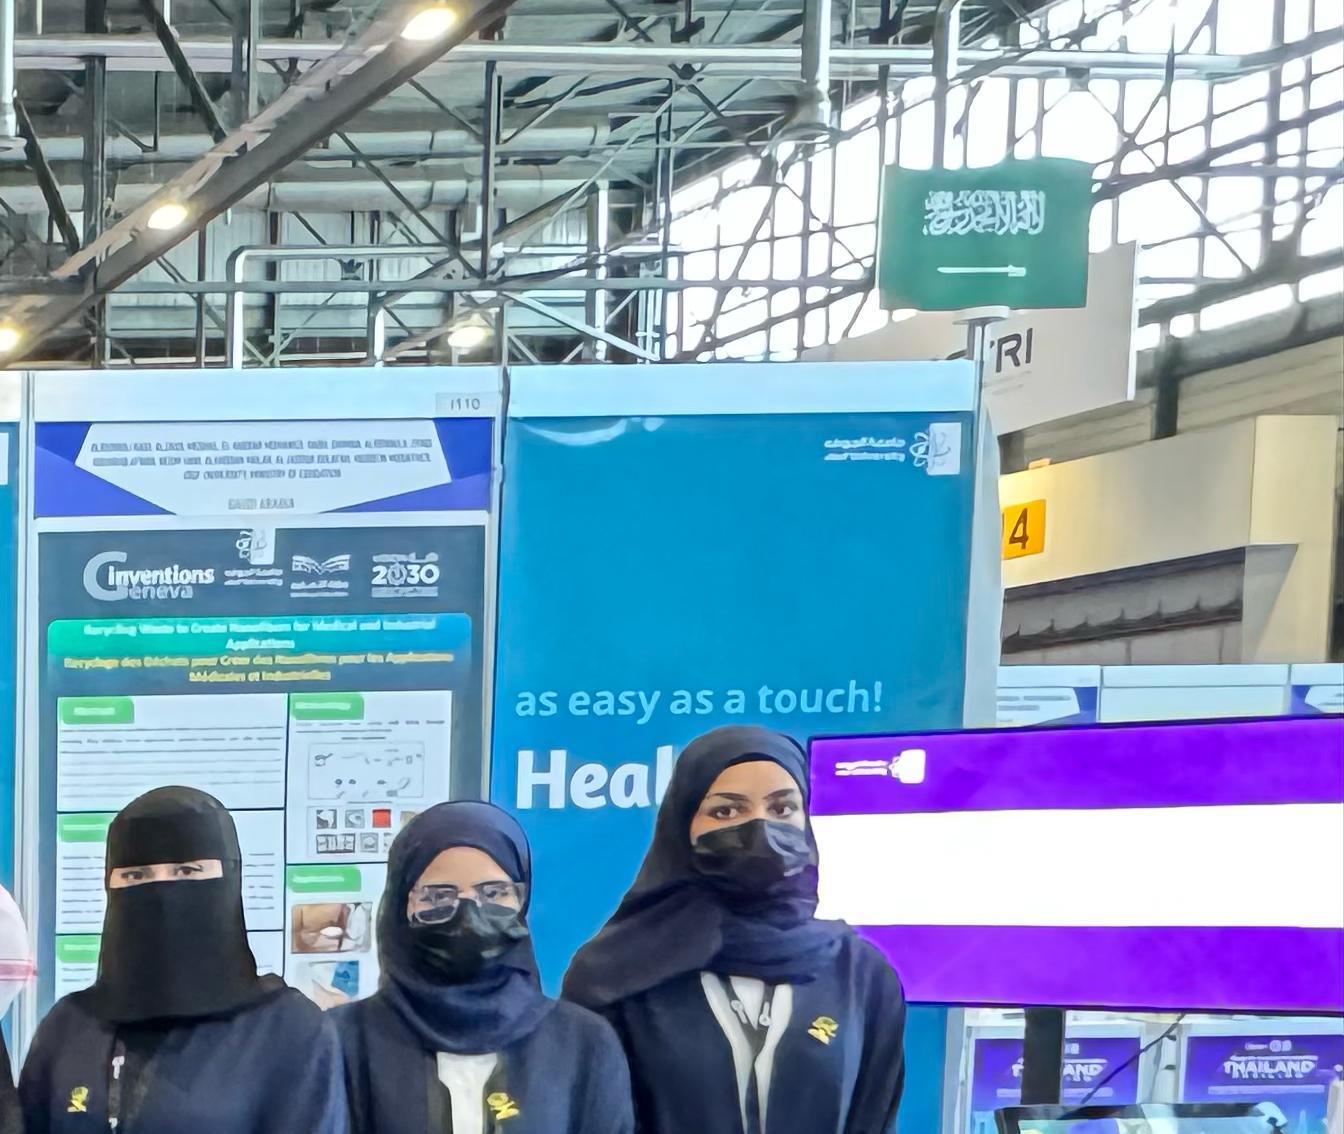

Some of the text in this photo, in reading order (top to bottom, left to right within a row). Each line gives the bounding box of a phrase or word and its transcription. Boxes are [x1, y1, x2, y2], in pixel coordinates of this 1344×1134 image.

[371, 564, 440, 585] 2030
[515, 680, 883, 725] as easy as a touch!
[516, 745, 675, 810] Heal
